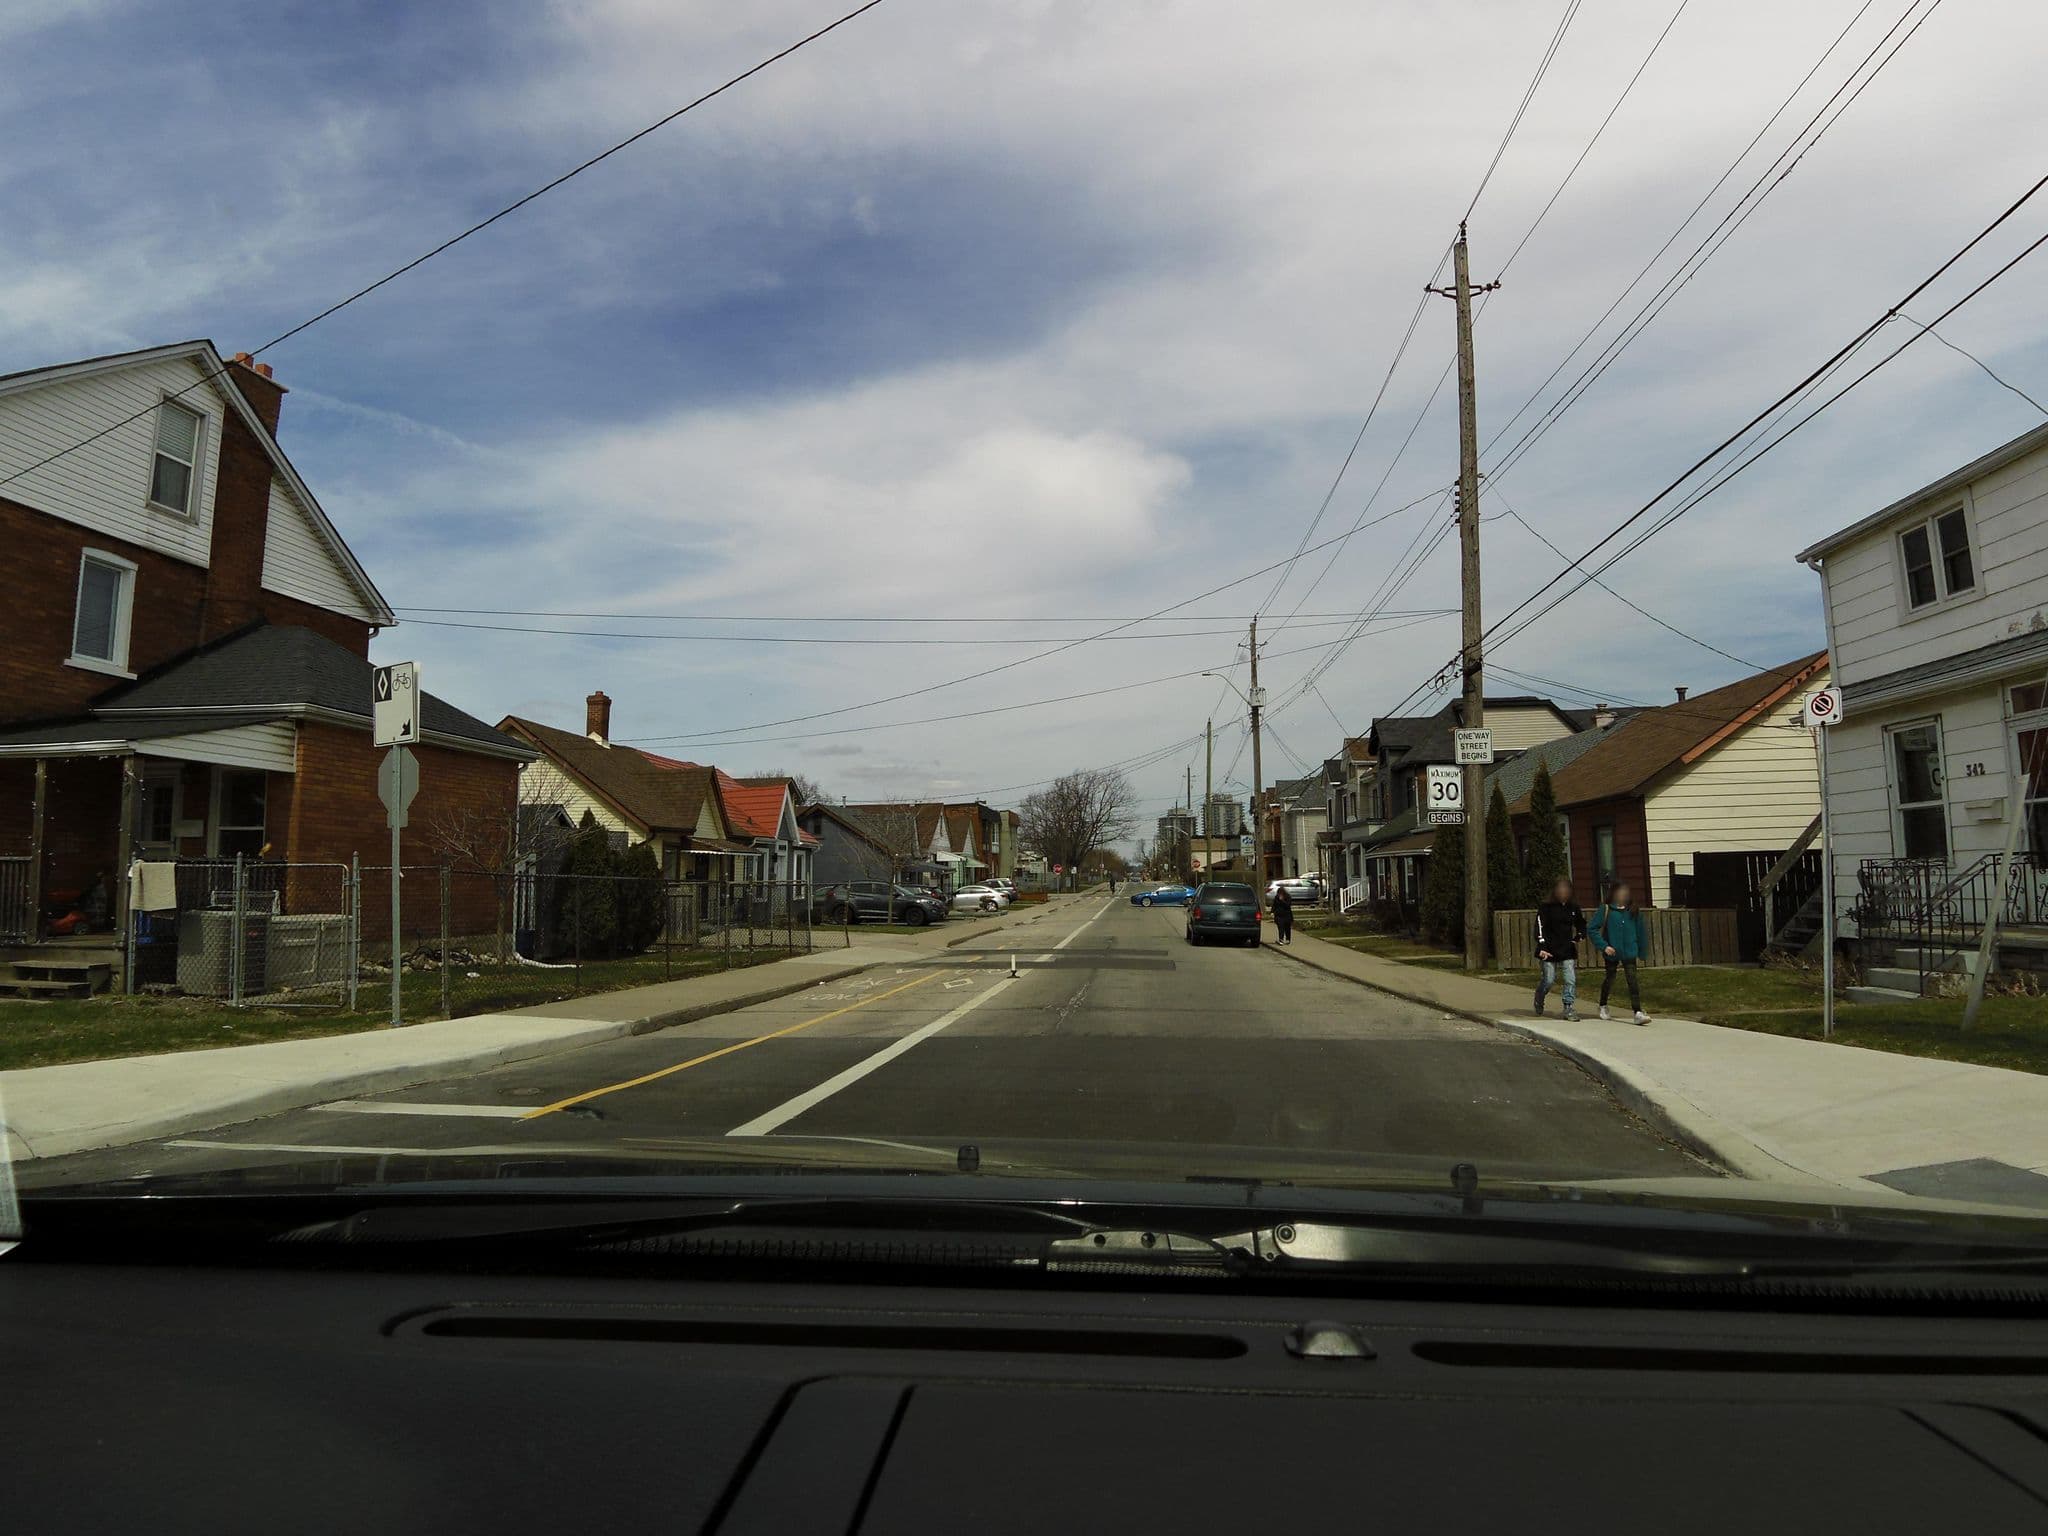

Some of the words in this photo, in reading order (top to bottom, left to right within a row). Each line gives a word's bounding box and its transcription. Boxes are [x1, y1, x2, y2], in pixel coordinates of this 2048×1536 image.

[1458, 732, 1473, 740] ONE
[1475, 732, 1490, 740] WAY
[1460, 742, 1488, 750] STREET
[1461, 752, 1488, 760] BEGINS
[1432, 782, 1459, 801] 30
[1430, 813, 1462, 823] BEGINS
